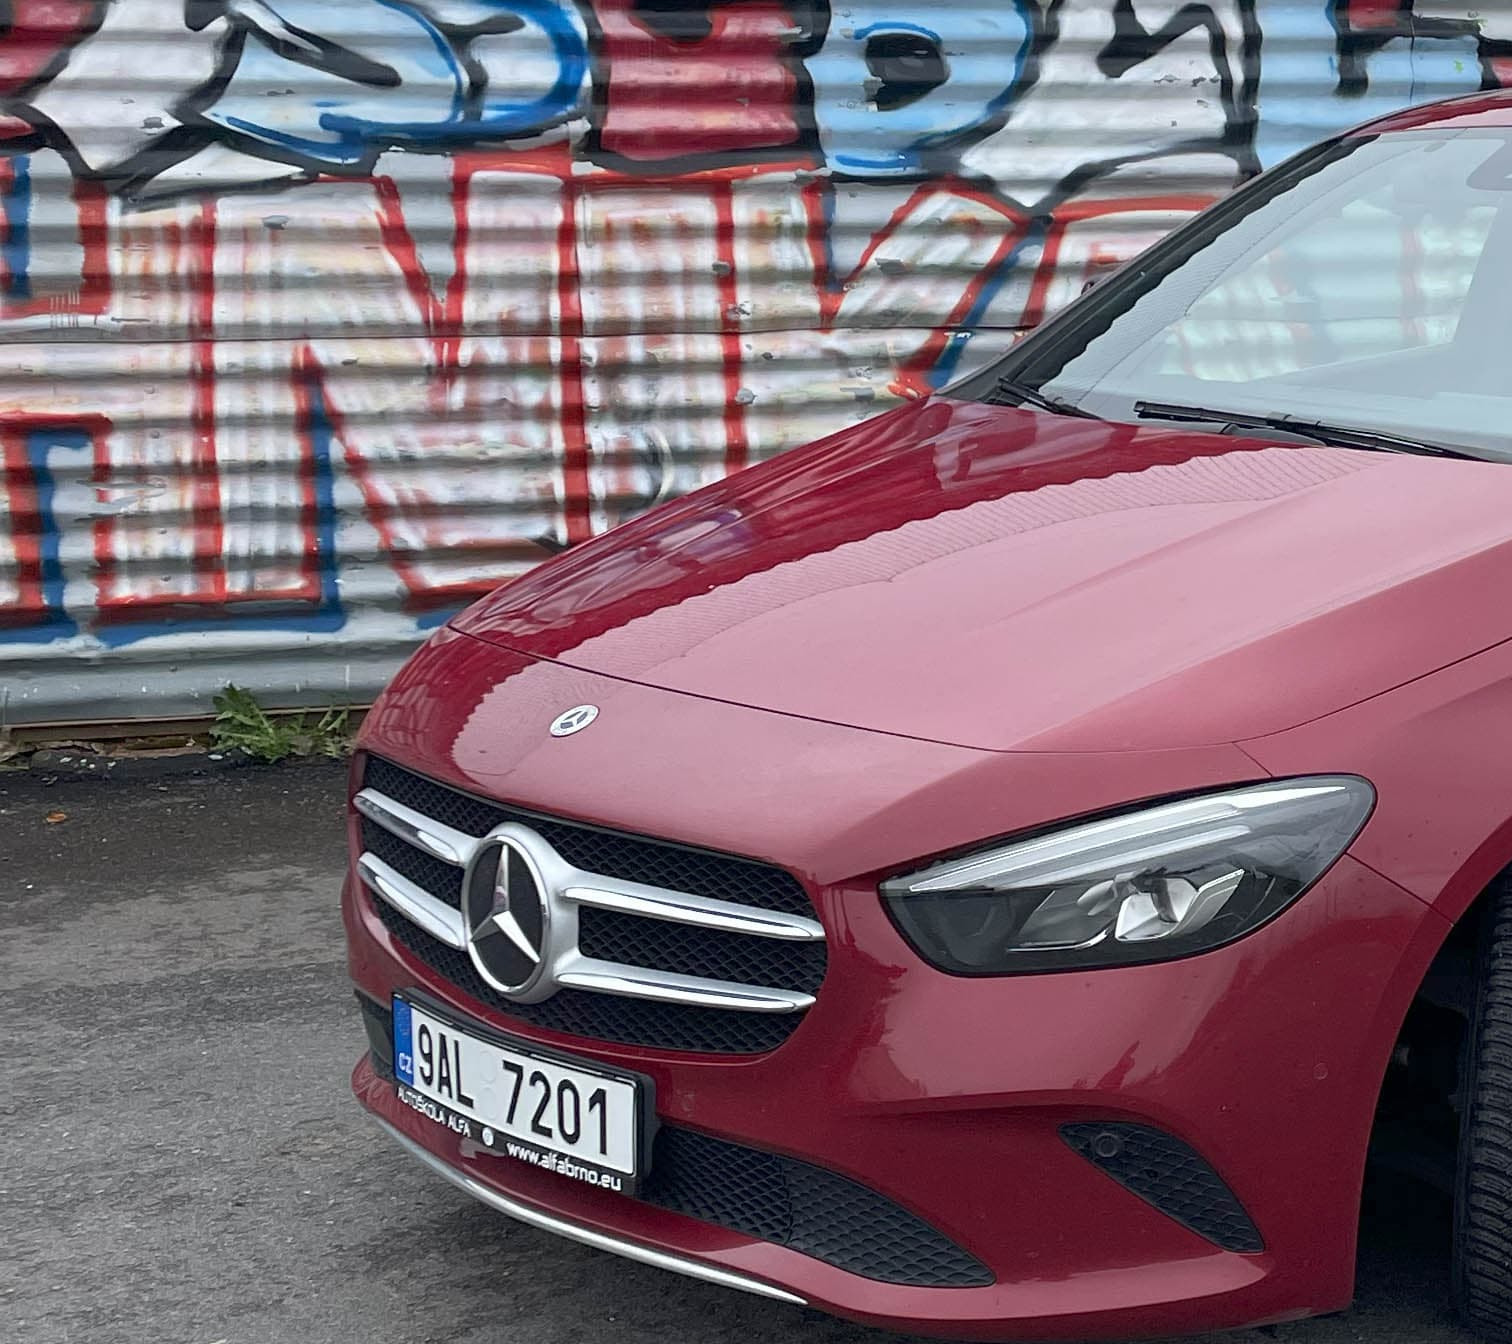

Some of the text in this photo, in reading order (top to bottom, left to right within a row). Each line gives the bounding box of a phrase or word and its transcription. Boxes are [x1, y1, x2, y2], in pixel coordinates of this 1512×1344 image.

[398, 1051, 414, 1074] CZ
[417, 1023, 608, 1156] 9AL 7201
[447, 1114, 472, 1138] ALFA
[505, 1141, 622, 1192] www.alfabrno.eu
